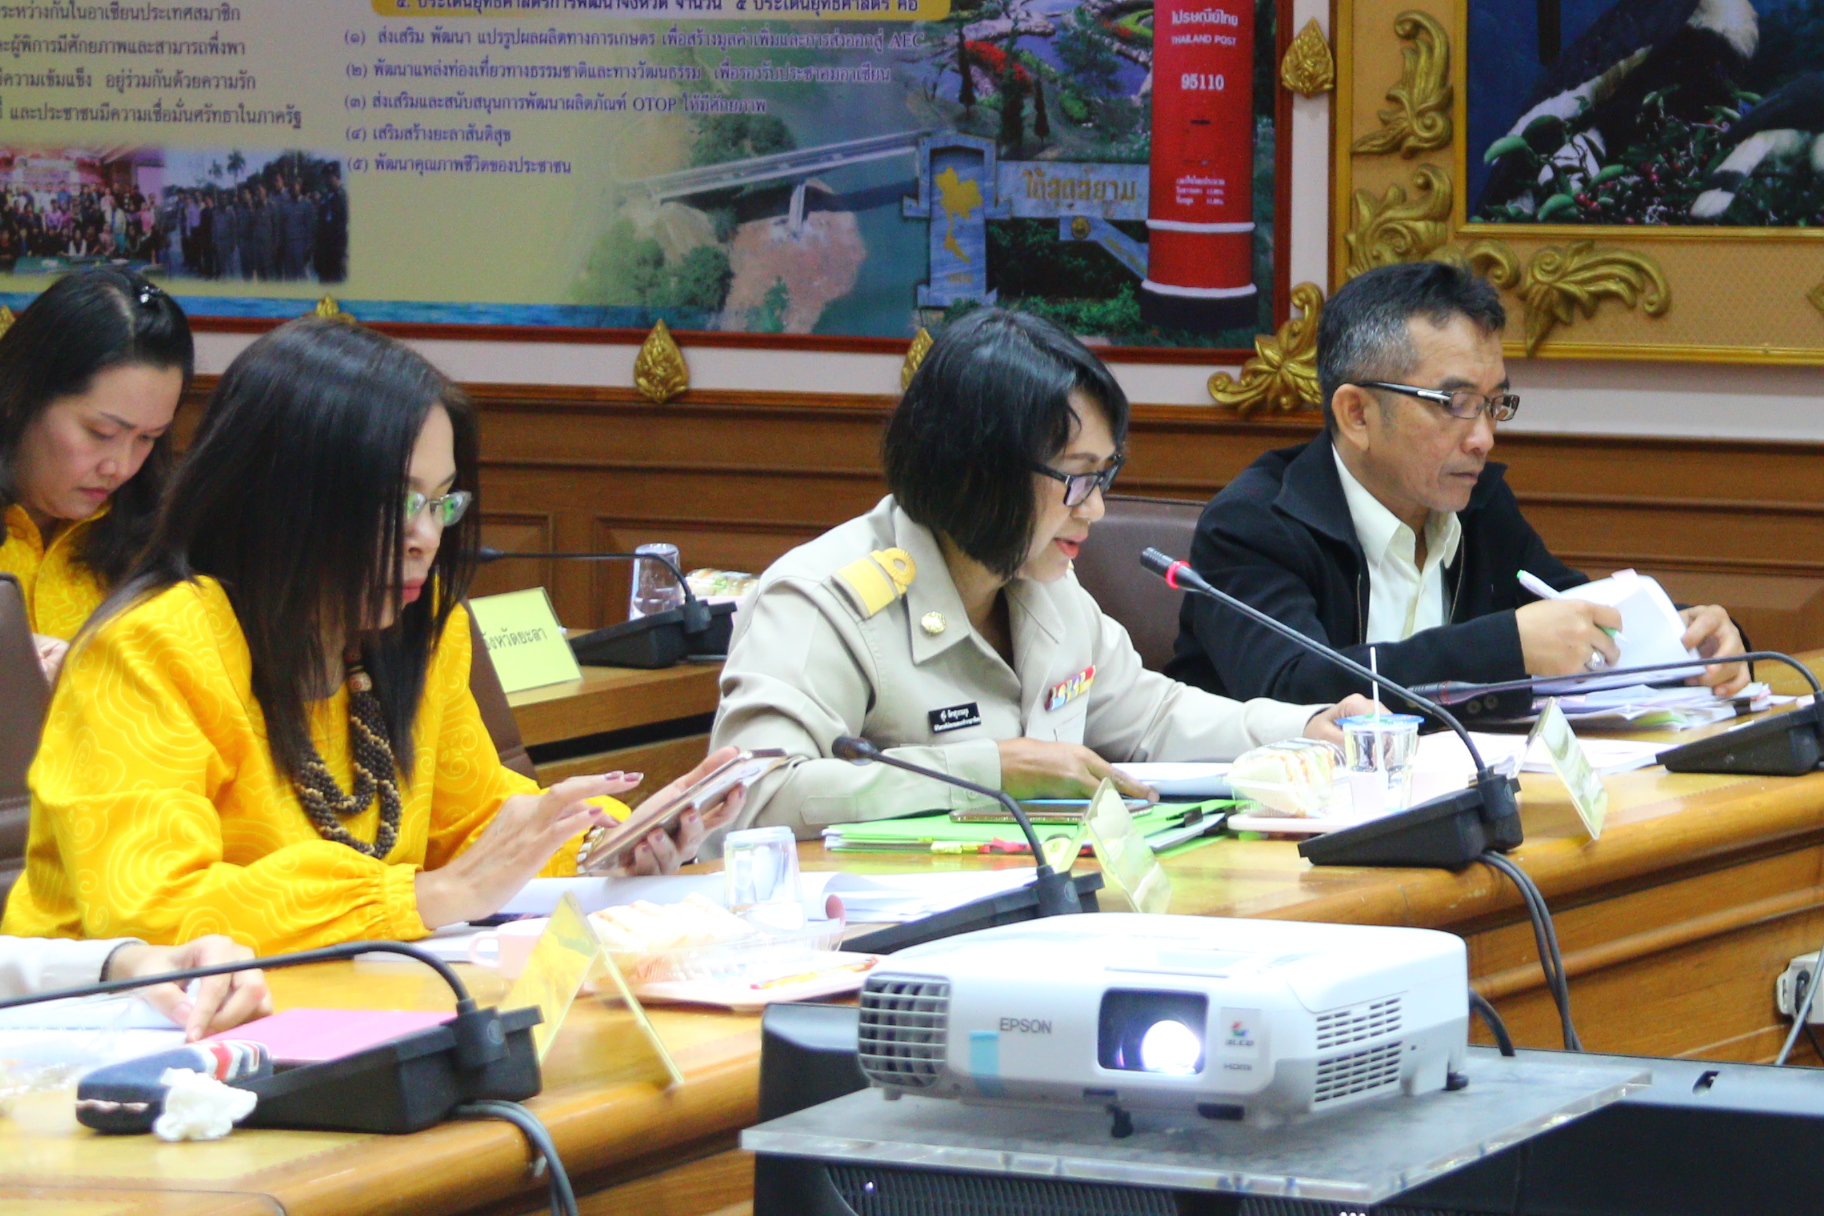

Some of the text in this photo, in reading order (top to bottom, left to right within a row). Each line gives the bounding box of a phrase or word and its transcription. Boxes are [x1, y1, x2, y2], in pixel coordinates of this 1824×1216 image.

[0, 0, 240, 21] ระหว่างกันในอาเซียนประเทศสมาชิก
[0, 32, 245, 58] ะผู้พิการมีศักยภาพและสามารถพึ่งพา
[378, 26, 424, 44] ส่งเสริม
[431, 27, 471, 44] พัฒนา
[478, 28, 654, 50] แปรรูปผลผลิตทางการเกษตร
[889, 32, 926, 49] AEC
[1214, 34, 1237, 45] POST
[375, 54, 701, 80] พัฒนาแหล่งท่องเที่ยวทางธรรมชาติและทางวัฒนธรรม
[0, 67, 256, 93] ความเข้มแข็ง อยู่ร่วมกันด้วยความรัก
[1180, 74, 1225, 91] 95110
[373, 91, 626, 114] ส่งเสริมและสนับสนุนการพัฒนาผลิตภัณฑ์
[633, 97, 676, 111] OTOP
[683, 94, 767, 114] ให้มีศักยภาพ
[373, 123, 511, 147] เสริมสร้างยะลาสันติสุข
[375, 153, 571, 176] พัฒนาคุณภาพชีวิตของประชาชน
[482, 627, 548, 651] ังหวัดยะลา
[999, 1017, 1052, 1034] EPSON
